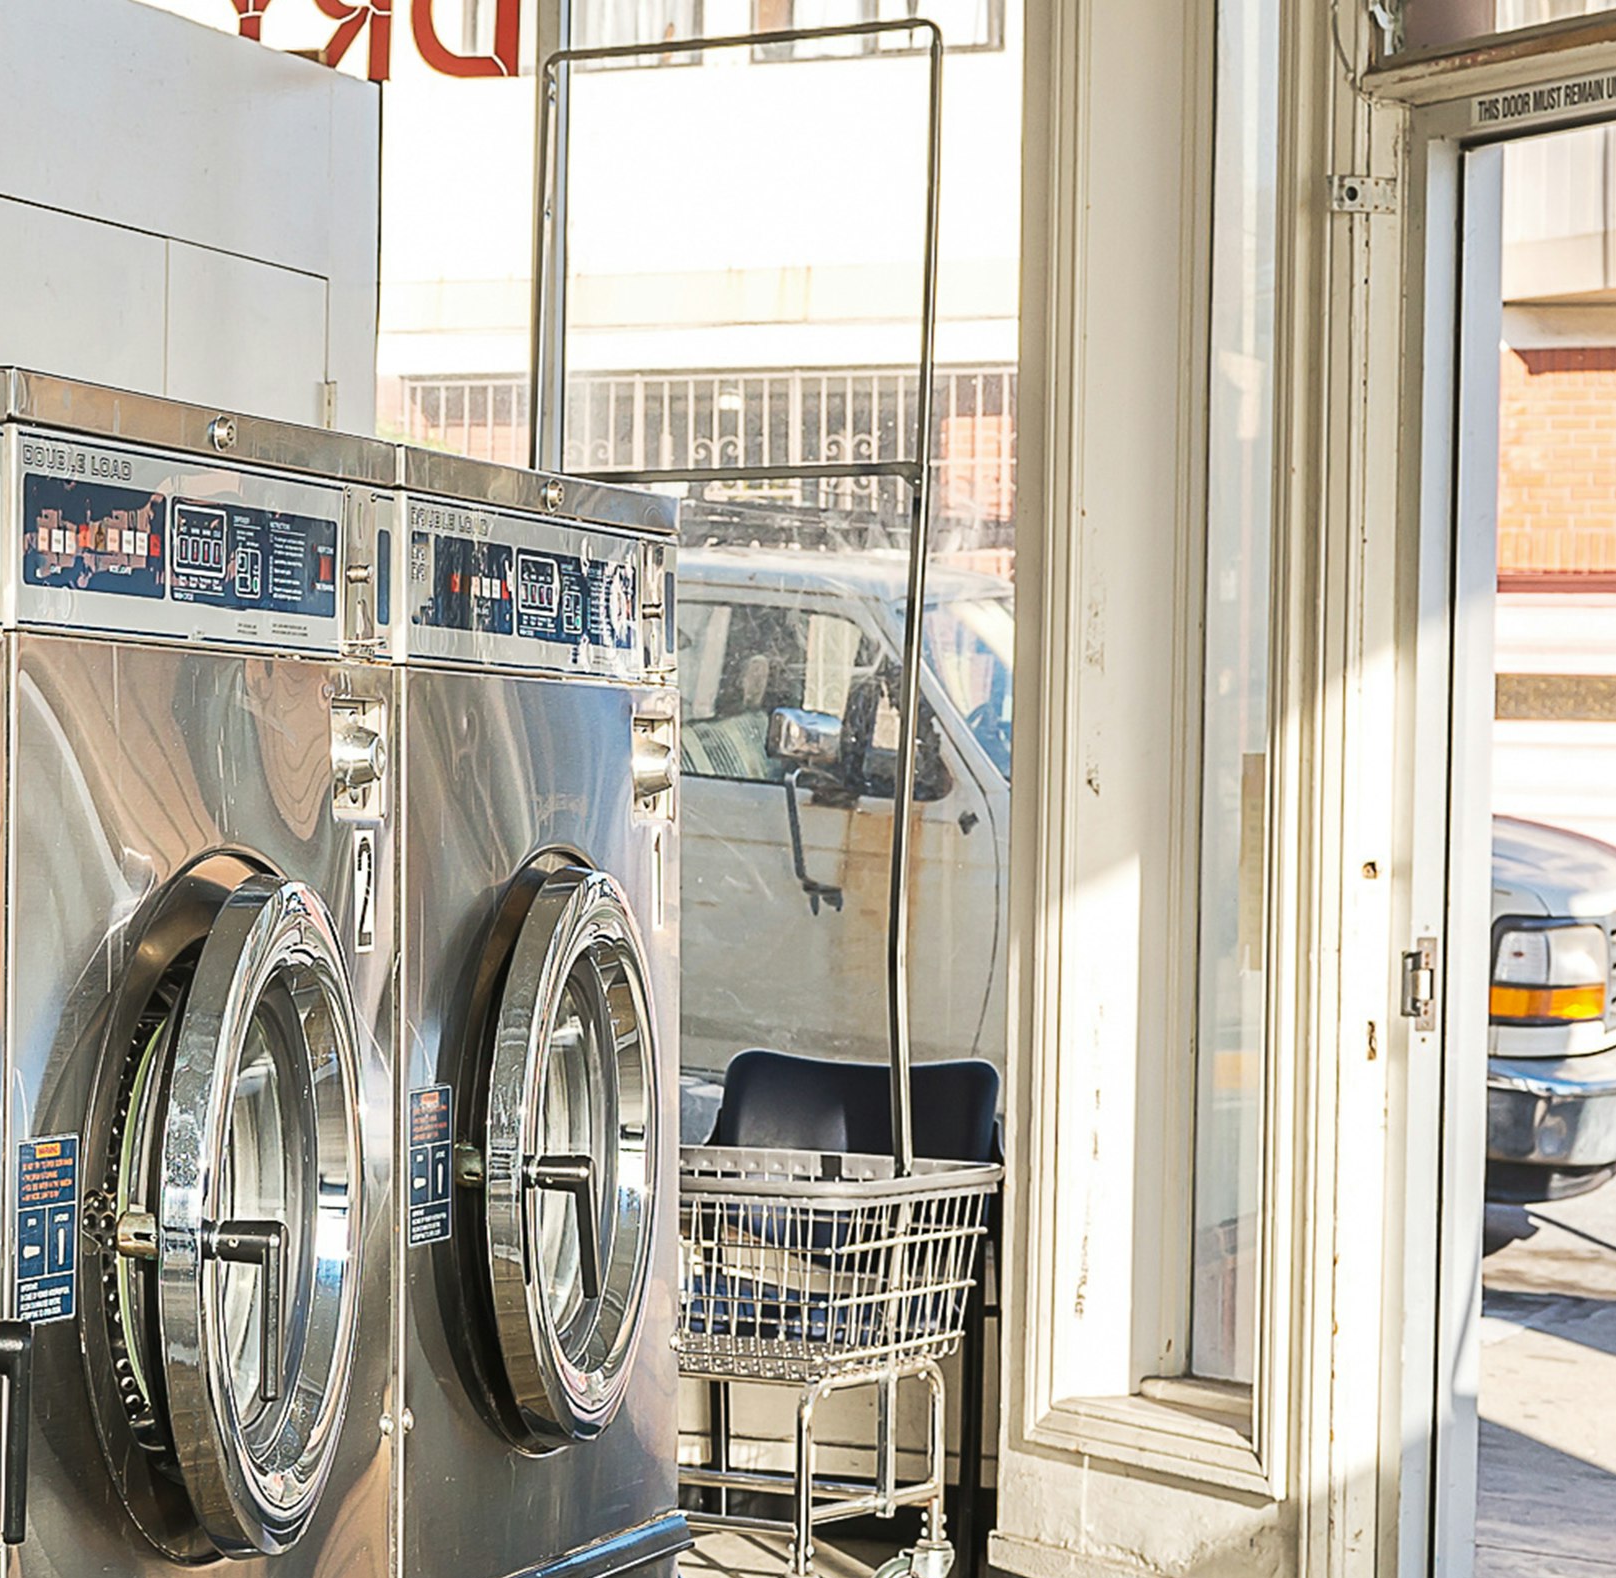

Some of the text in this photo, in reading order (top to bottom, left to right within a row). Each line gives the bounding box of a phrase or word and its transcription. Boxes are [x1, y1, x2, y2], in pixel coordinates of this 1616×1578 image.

[1478, 98, 1499, 121] THIS
[1503, 93, 1530, 118] DOOR
[1533, 86, 1562, 112] MUST
[1564, 79, 1604, 106] REMAIN
[91, 456, 132, 481] LOAD
[357, 836, 372, 947] 2
